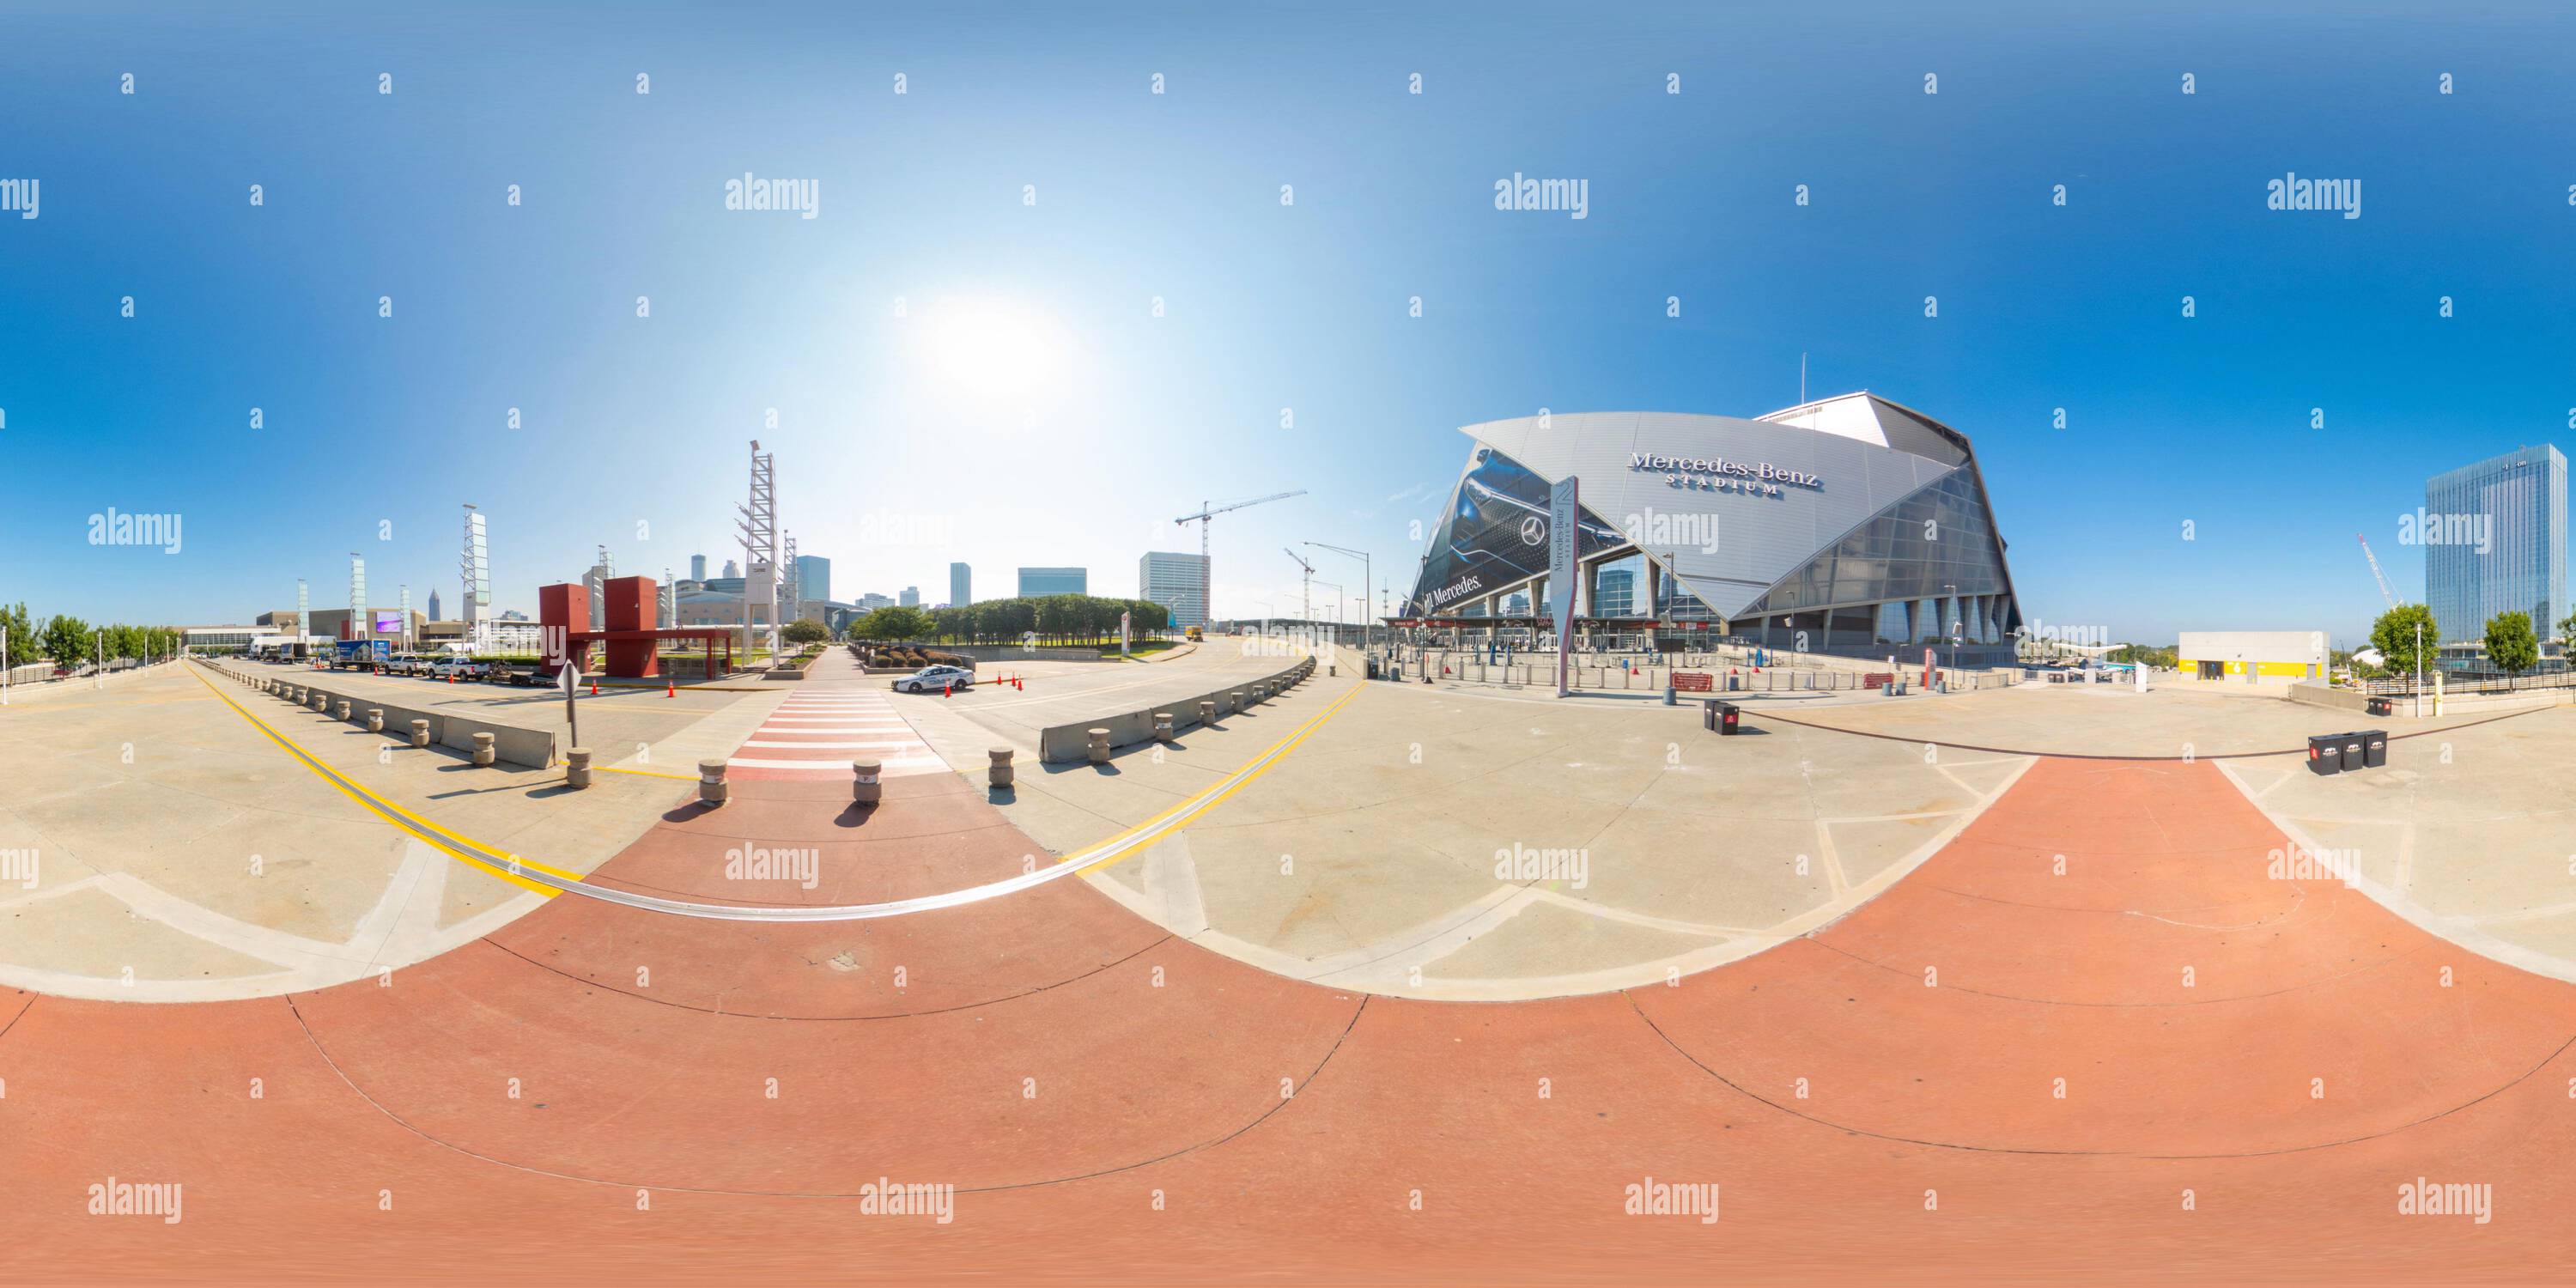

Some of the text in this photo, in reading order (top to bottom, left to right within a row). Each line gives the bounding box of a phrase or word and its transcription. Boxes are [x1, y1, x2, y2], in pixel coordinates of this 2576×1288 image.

[1628, 452, 1819, 488] Mercedes-Benz
[1665, 473, 1778, 495] STADIUM
[1555, 479, 1574, 506] 2
[1554, 508, 1564, 572] Mercedes-Benz
[1433, 574, 1482, 606] Mercedes.
[2233, 662, 2241, 673] 6
